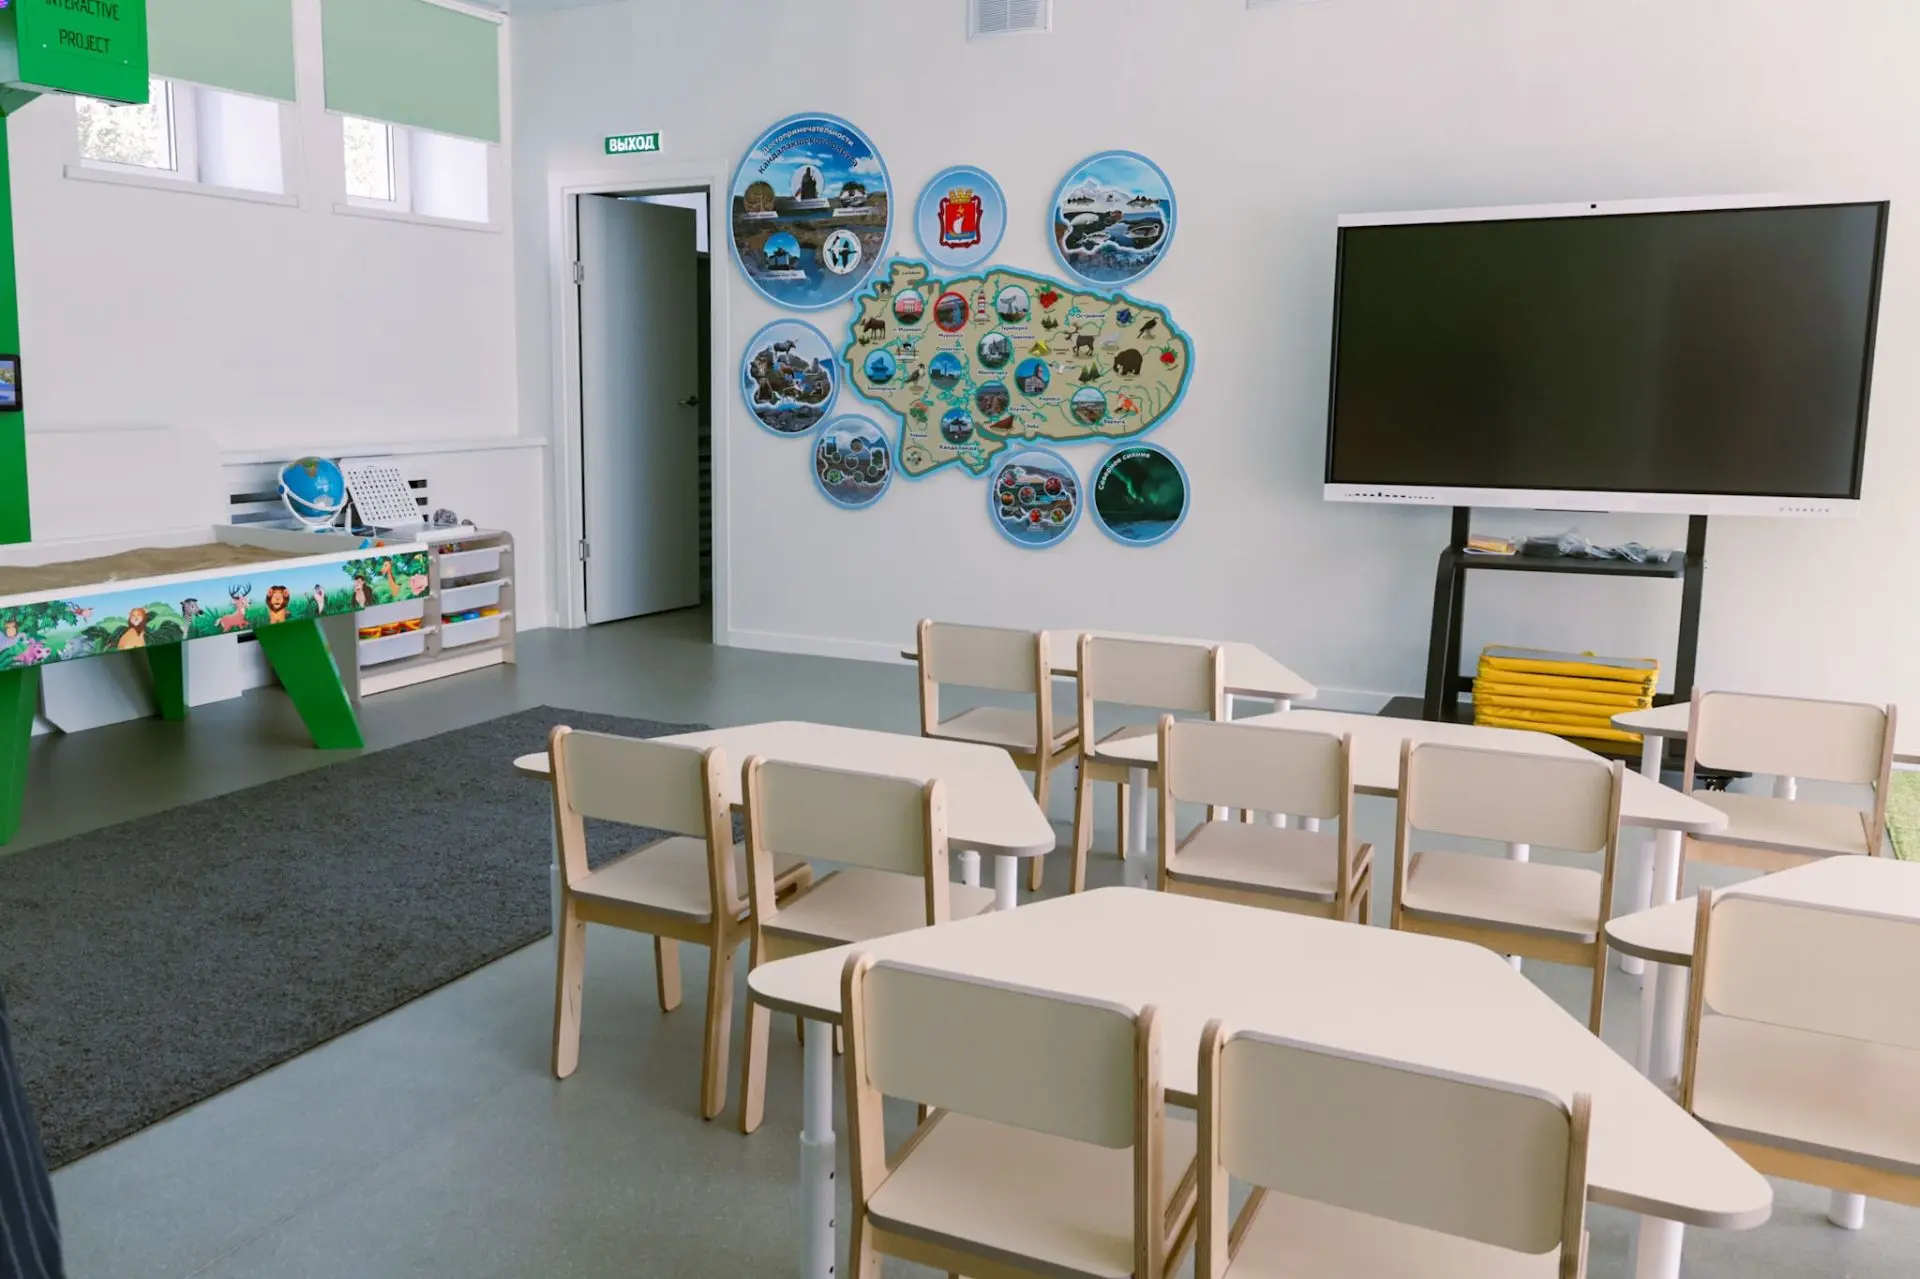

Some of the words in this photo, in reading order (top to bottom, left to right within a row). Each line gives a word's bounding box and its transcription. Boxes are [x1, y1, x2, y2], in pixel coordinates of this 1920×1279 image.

[59, 29, 110, 54] PROJECT
[609, 136, 656, 152] ВЫХОД
[762, 126, 854, 155] Достопримечательности
